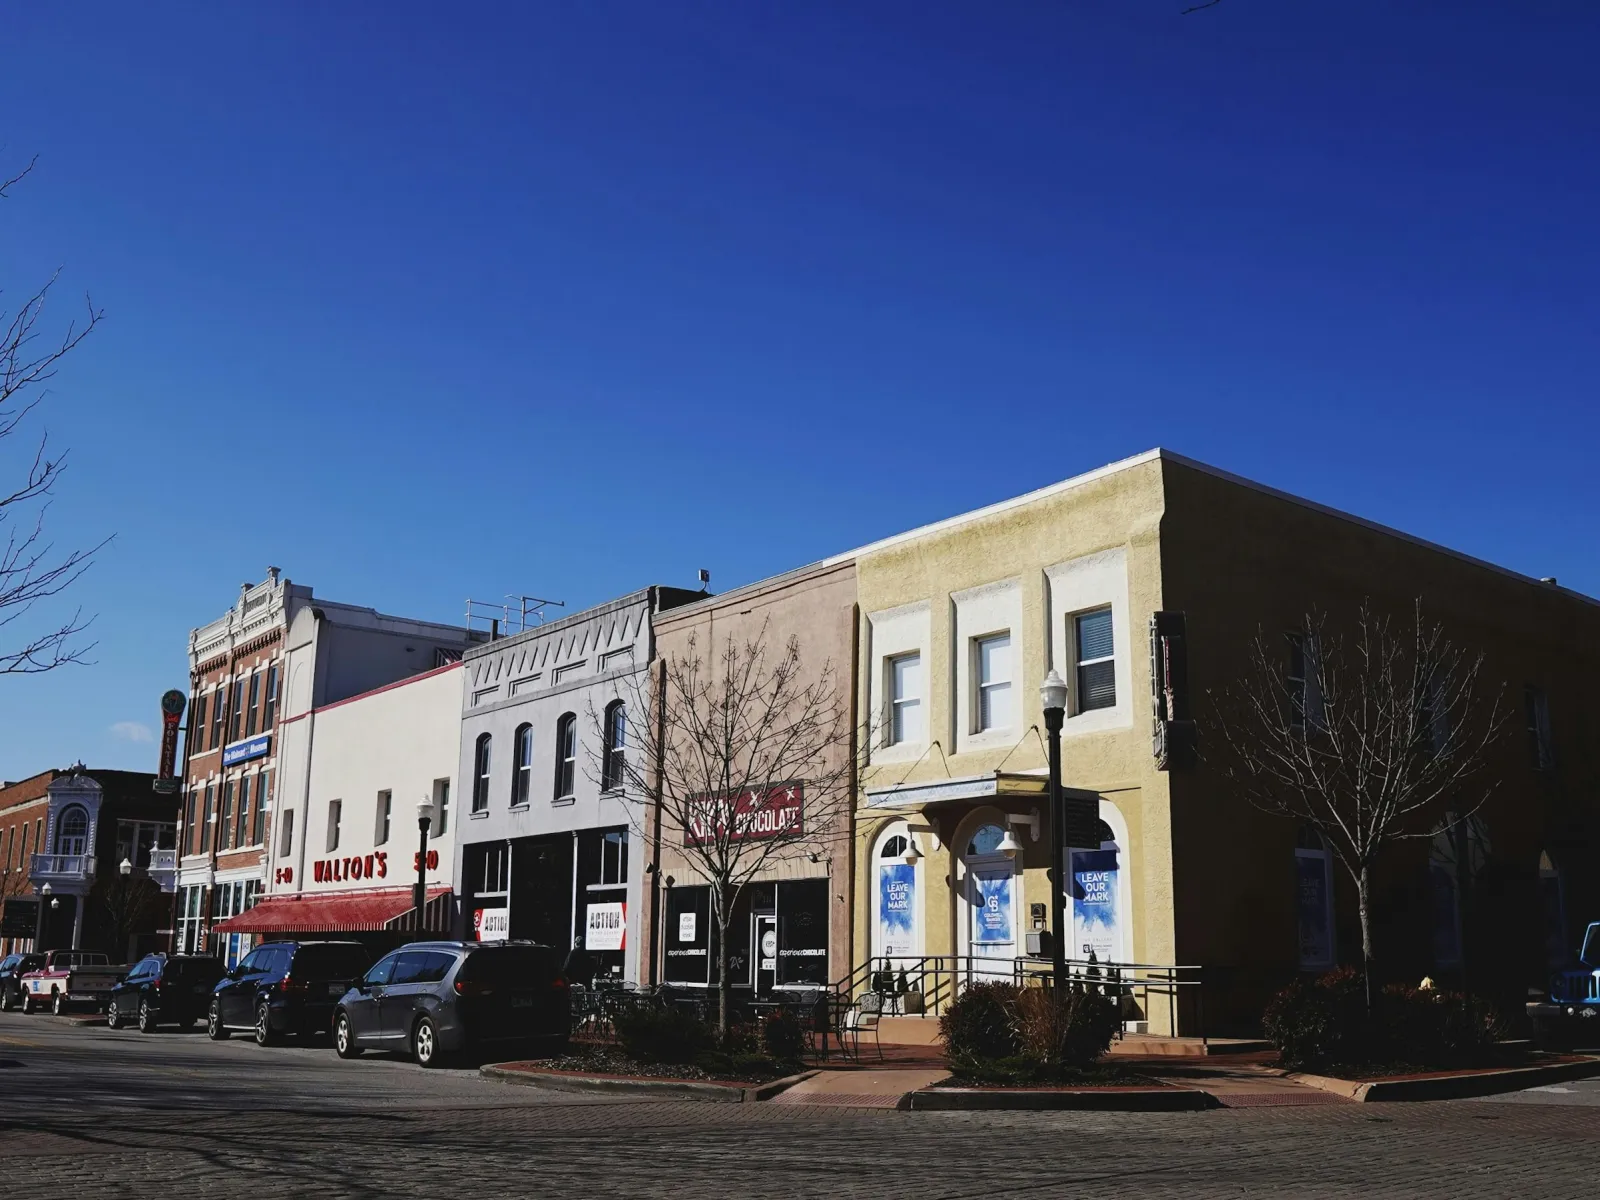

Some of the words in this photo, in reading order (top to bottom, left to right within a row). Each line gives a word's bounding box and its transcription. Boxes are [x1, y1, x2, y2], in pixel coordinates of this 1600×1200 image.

[735, 806, 800, 834] CHOCOLATE
[314, 851, 388, 883] WALTON'S
[1081, 872, 1109, 883] LEAVE
[887, 883, 909, 892] LEAVE
[1085, 882, 1106, 892] OUR
[890, 892, 906, 901] OUR
[1083, 891, 1109, 901] MARK
[887, 901, 909, 910] MARK
[589, 911, 620, 929] ACTION
